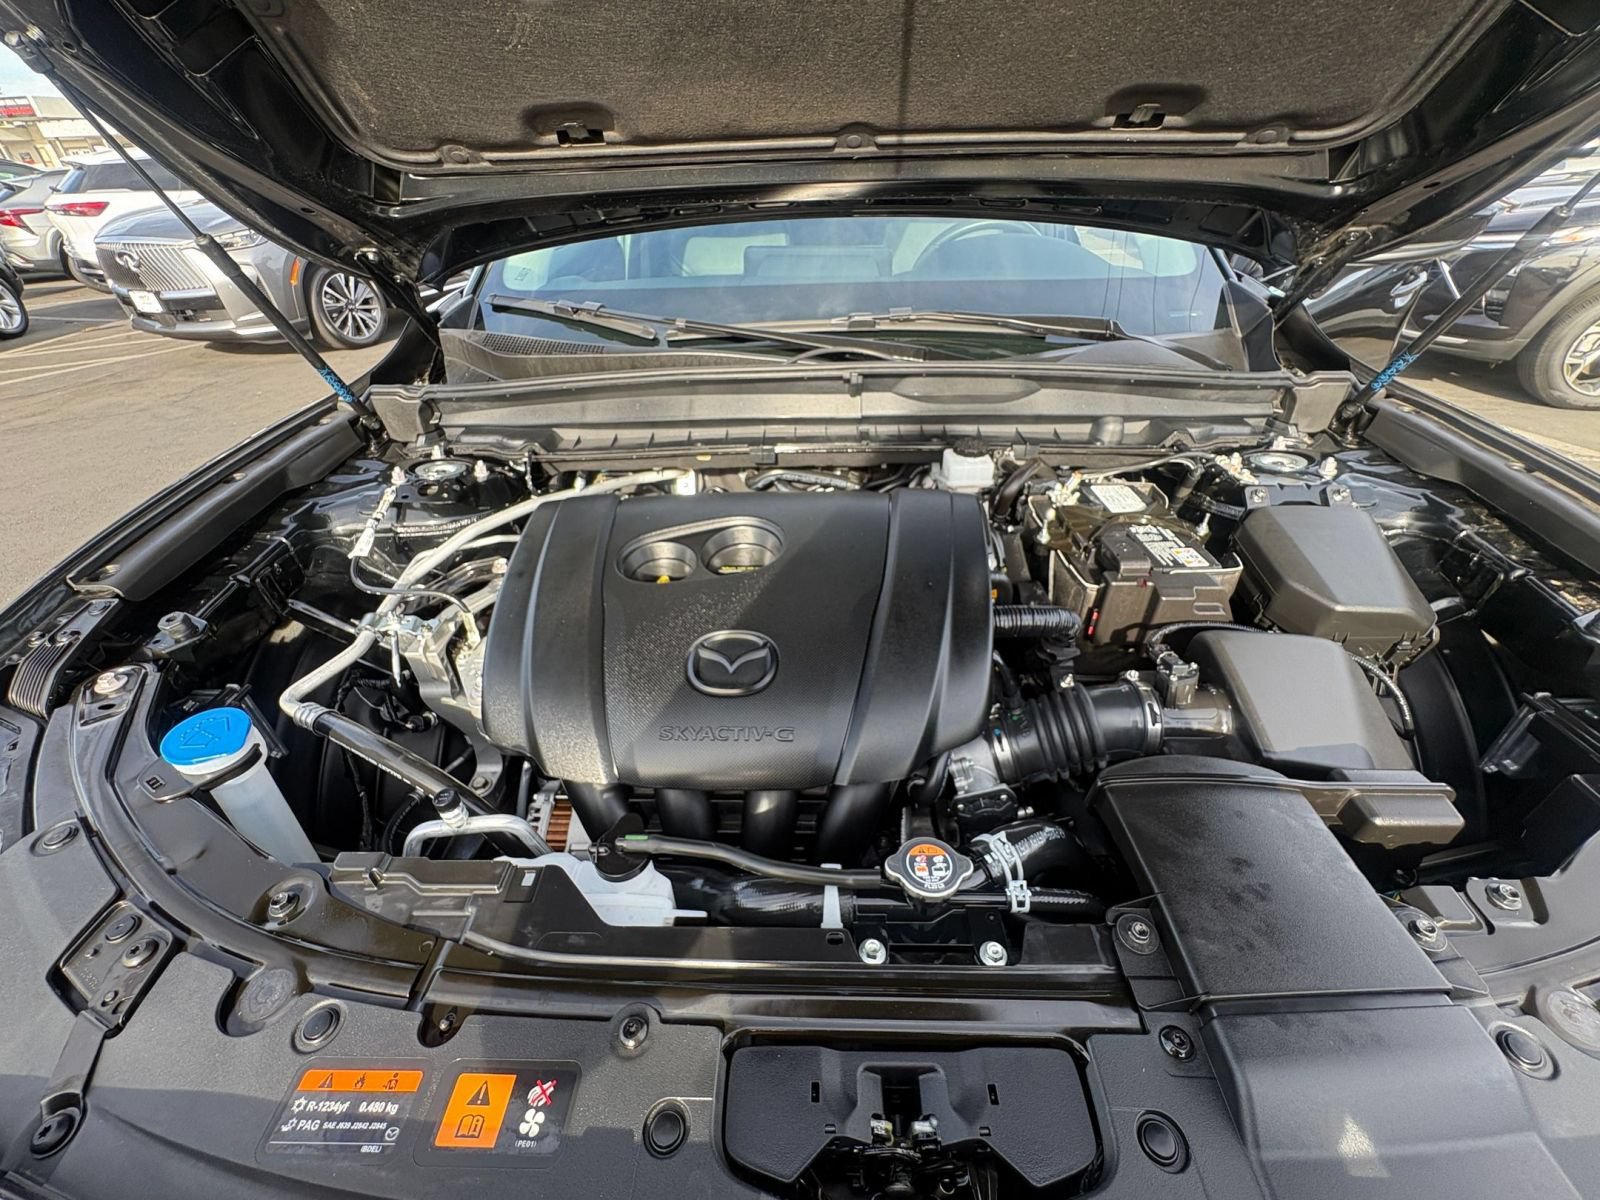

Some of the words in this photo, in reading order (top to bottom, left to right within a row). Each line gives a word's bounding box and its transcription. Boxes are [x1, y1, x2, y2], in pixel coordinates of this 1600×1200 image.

[659, 725, 795, 742] SKYACTIV-G
[306, 1101, 351, 1114] R-1234yf
[385, 1102, 399, 1115] kg
[296, 1119, 321, 1131] PAG
[322, 1121, 337, 1129] SAE
